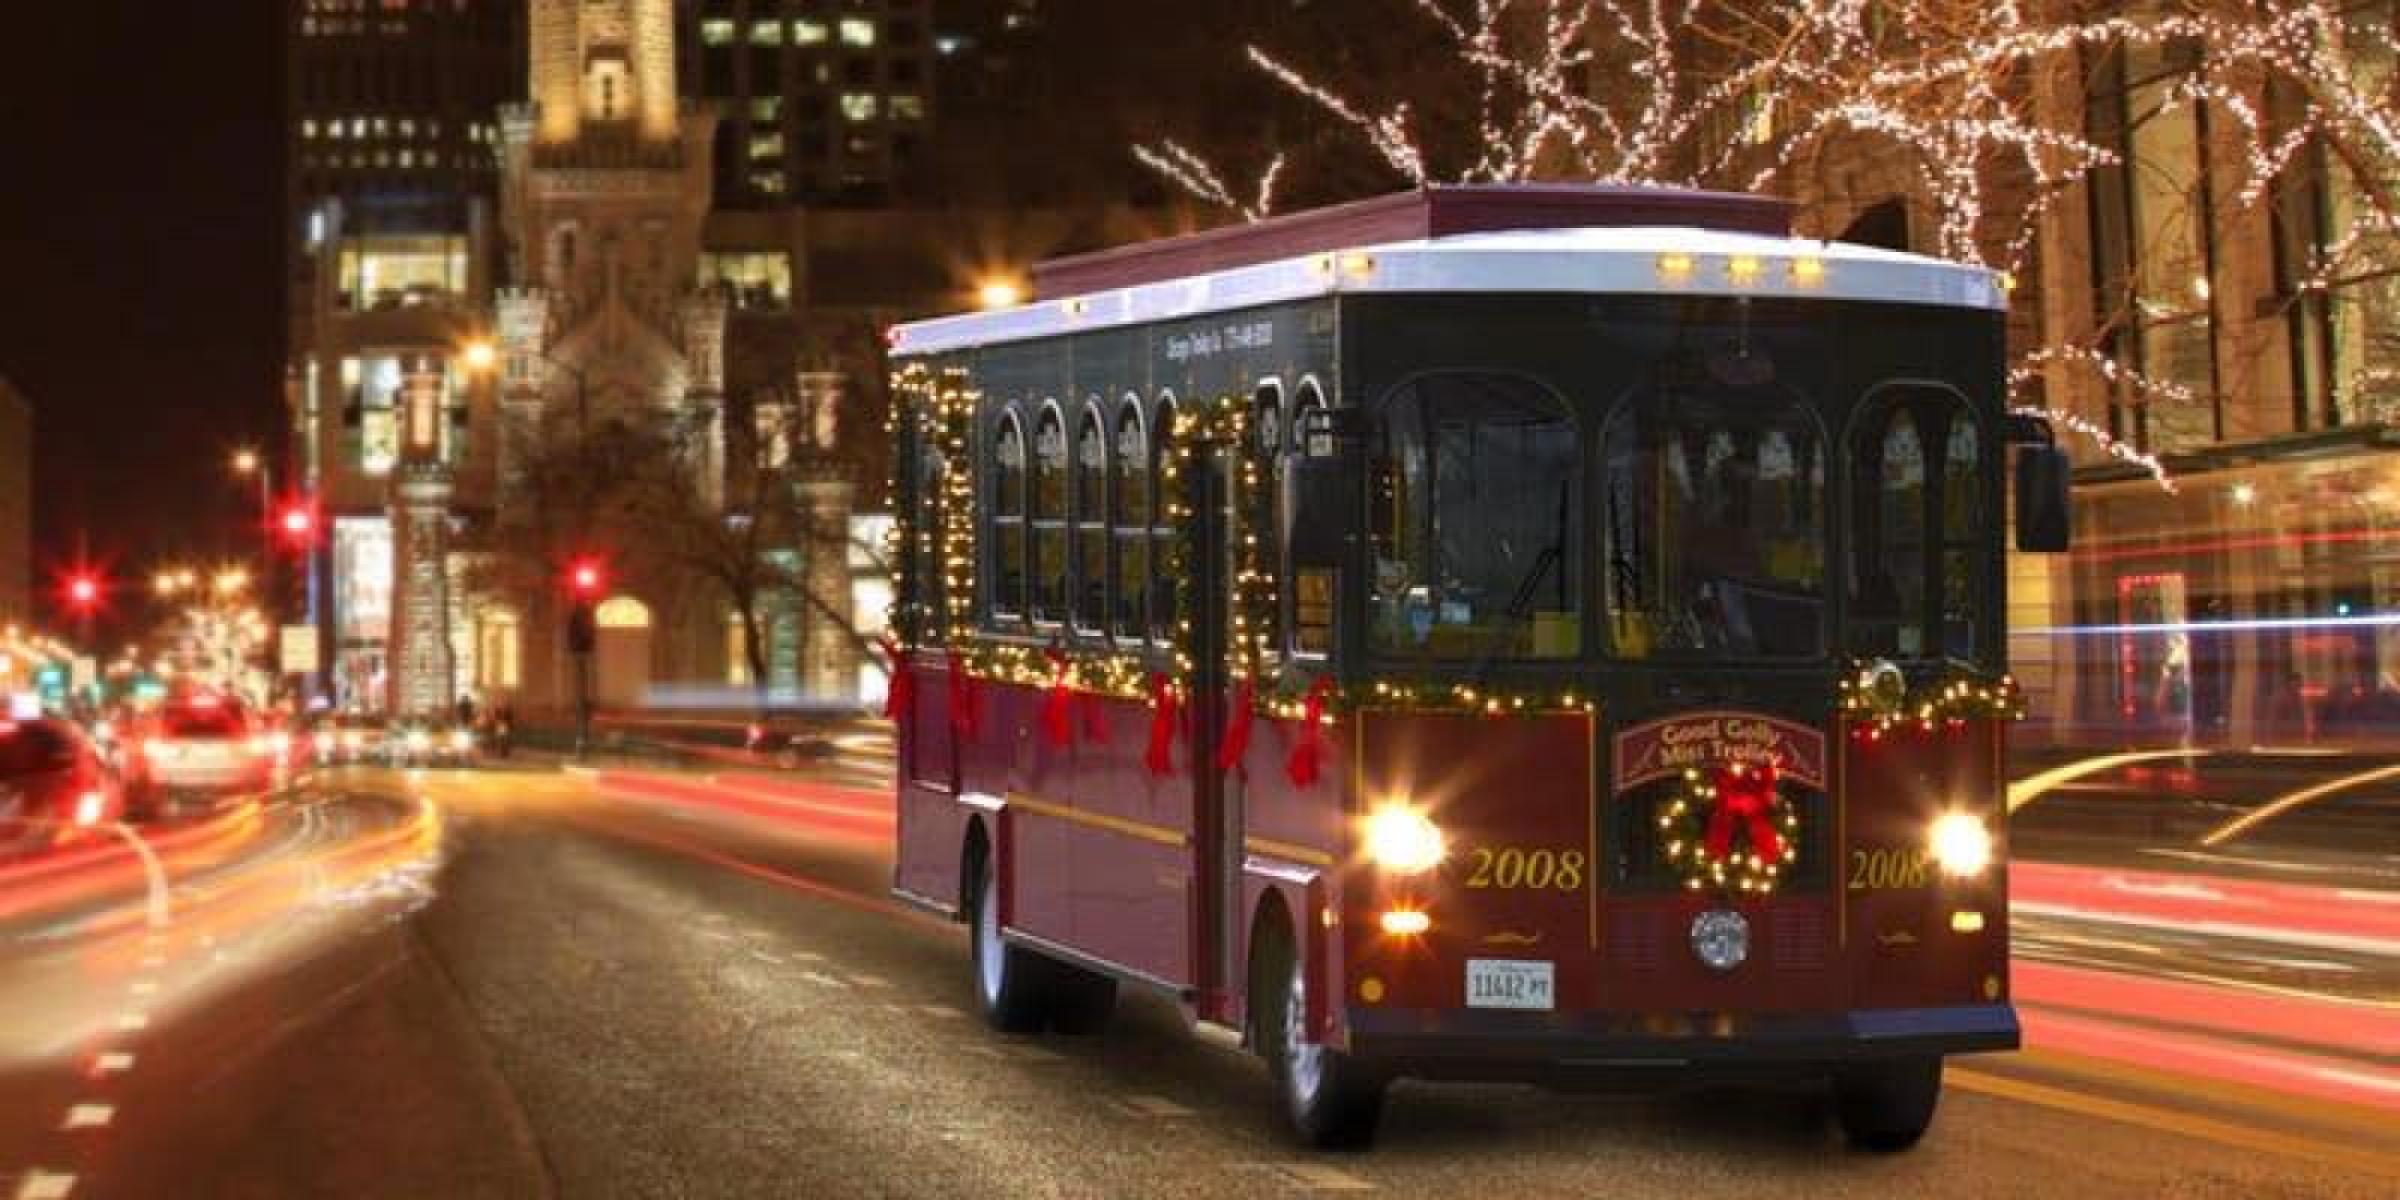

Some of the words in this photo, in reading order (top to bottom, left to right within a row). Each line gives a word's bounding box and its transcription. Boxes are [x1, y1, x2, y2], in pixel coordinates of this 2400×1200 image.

[1661, 720, 1719, 744] Good
[1727, 719, 1781, 747] Golly
[1465, 849, 1585, 890] 2008
[1848, 850, 1926, 889] 2008
